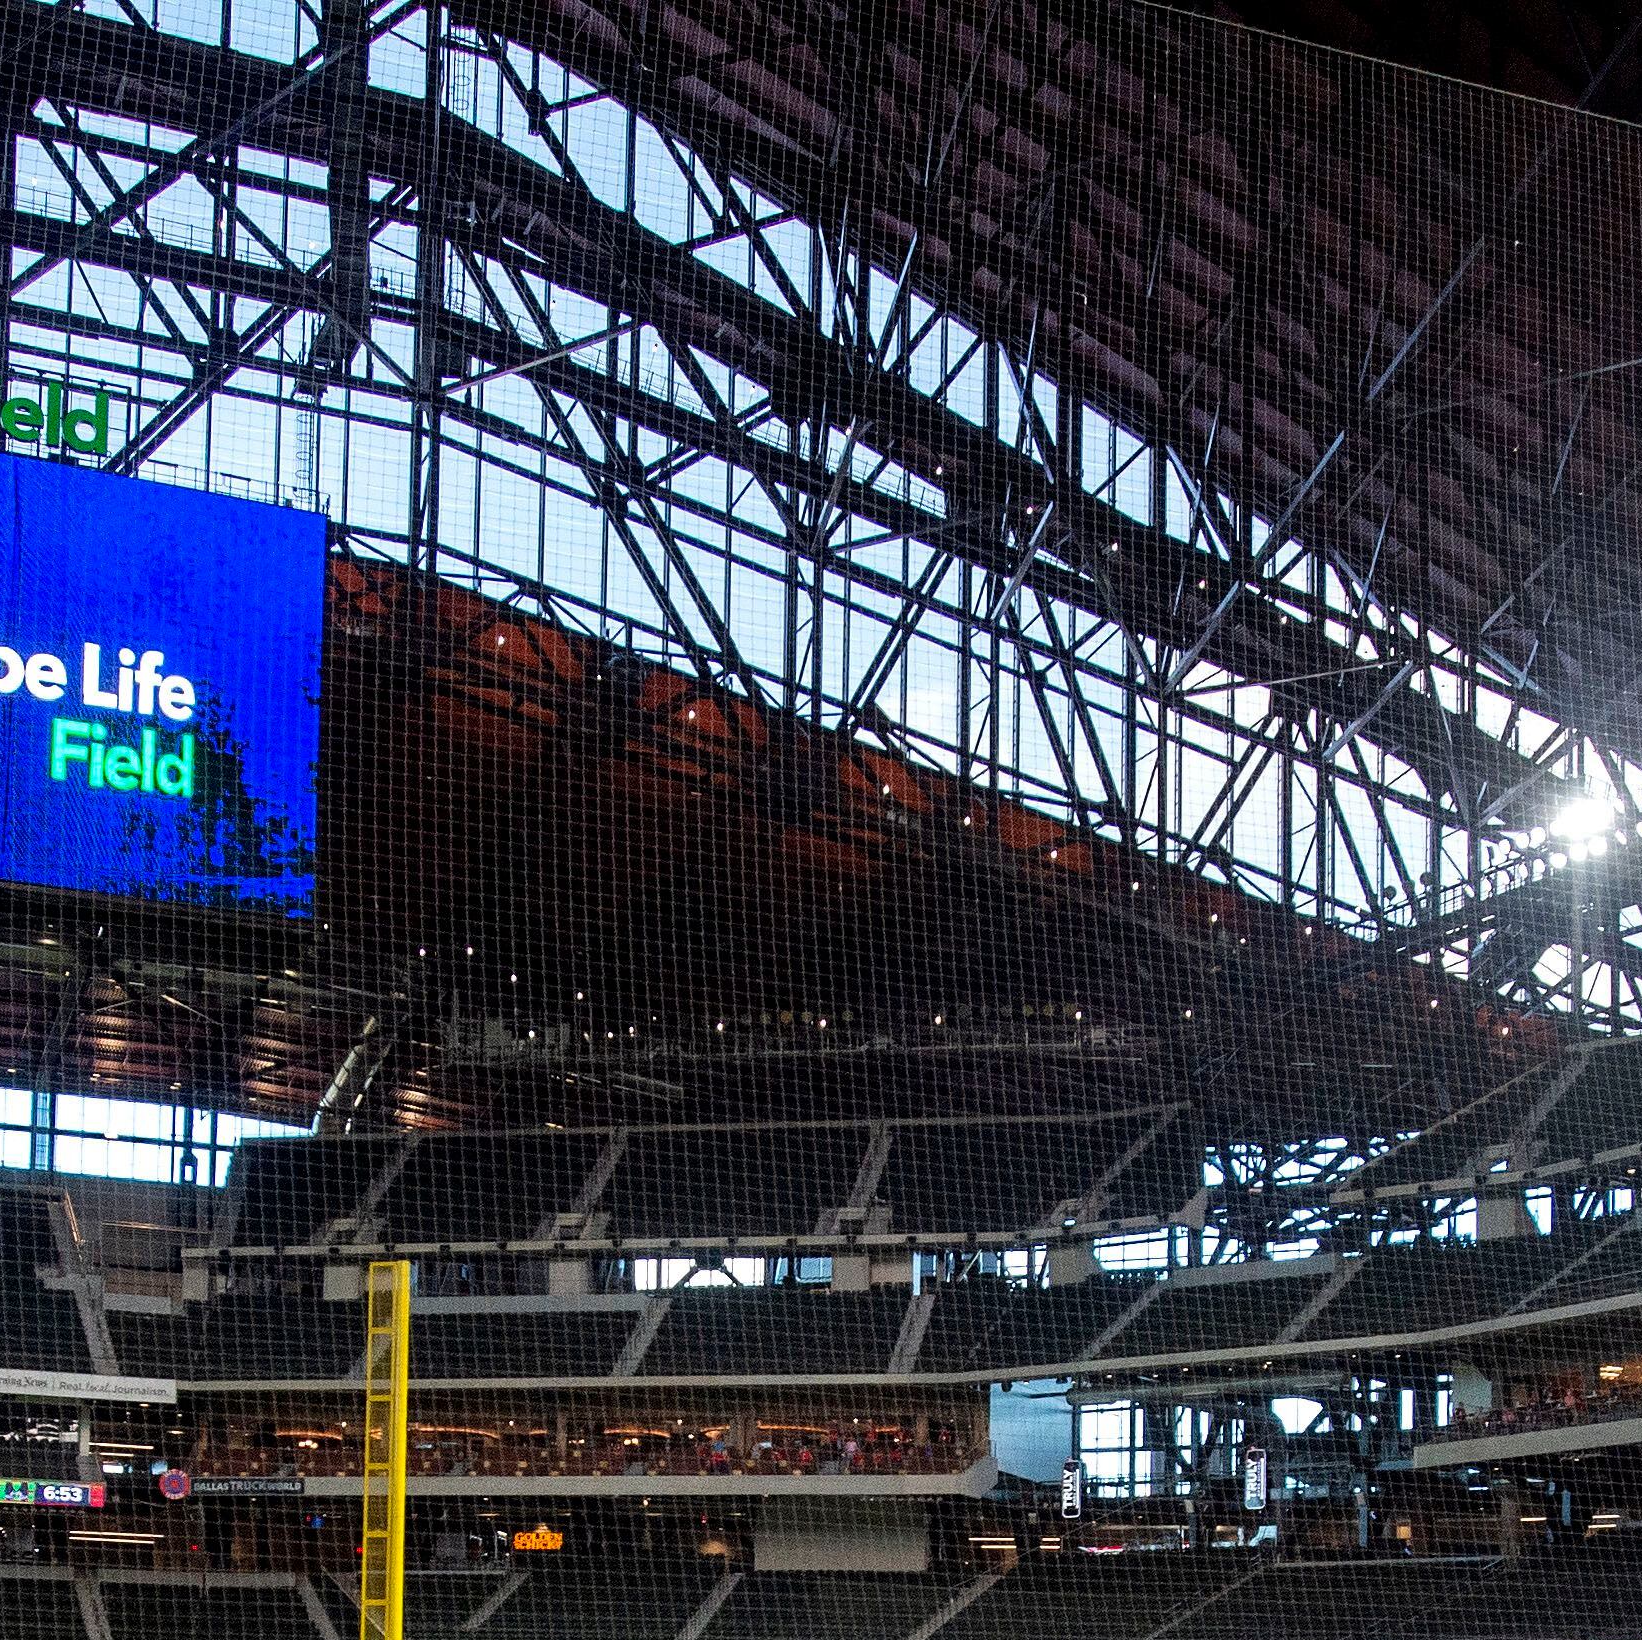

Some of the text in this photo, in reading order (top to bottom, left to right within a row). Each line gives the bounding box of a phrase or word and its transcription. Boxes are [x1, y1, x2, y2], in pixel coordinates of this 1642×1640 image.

[83, 642, 196, 721] Life
[50, 718, 195, 797] Field
[22, 1375, 48, 1389] News
[43, 1485, 83, 1502] 6:53
[1064, 1469, 1074, 1507] TRULY
[1247, 1458, 1257, 1499] TRULY
